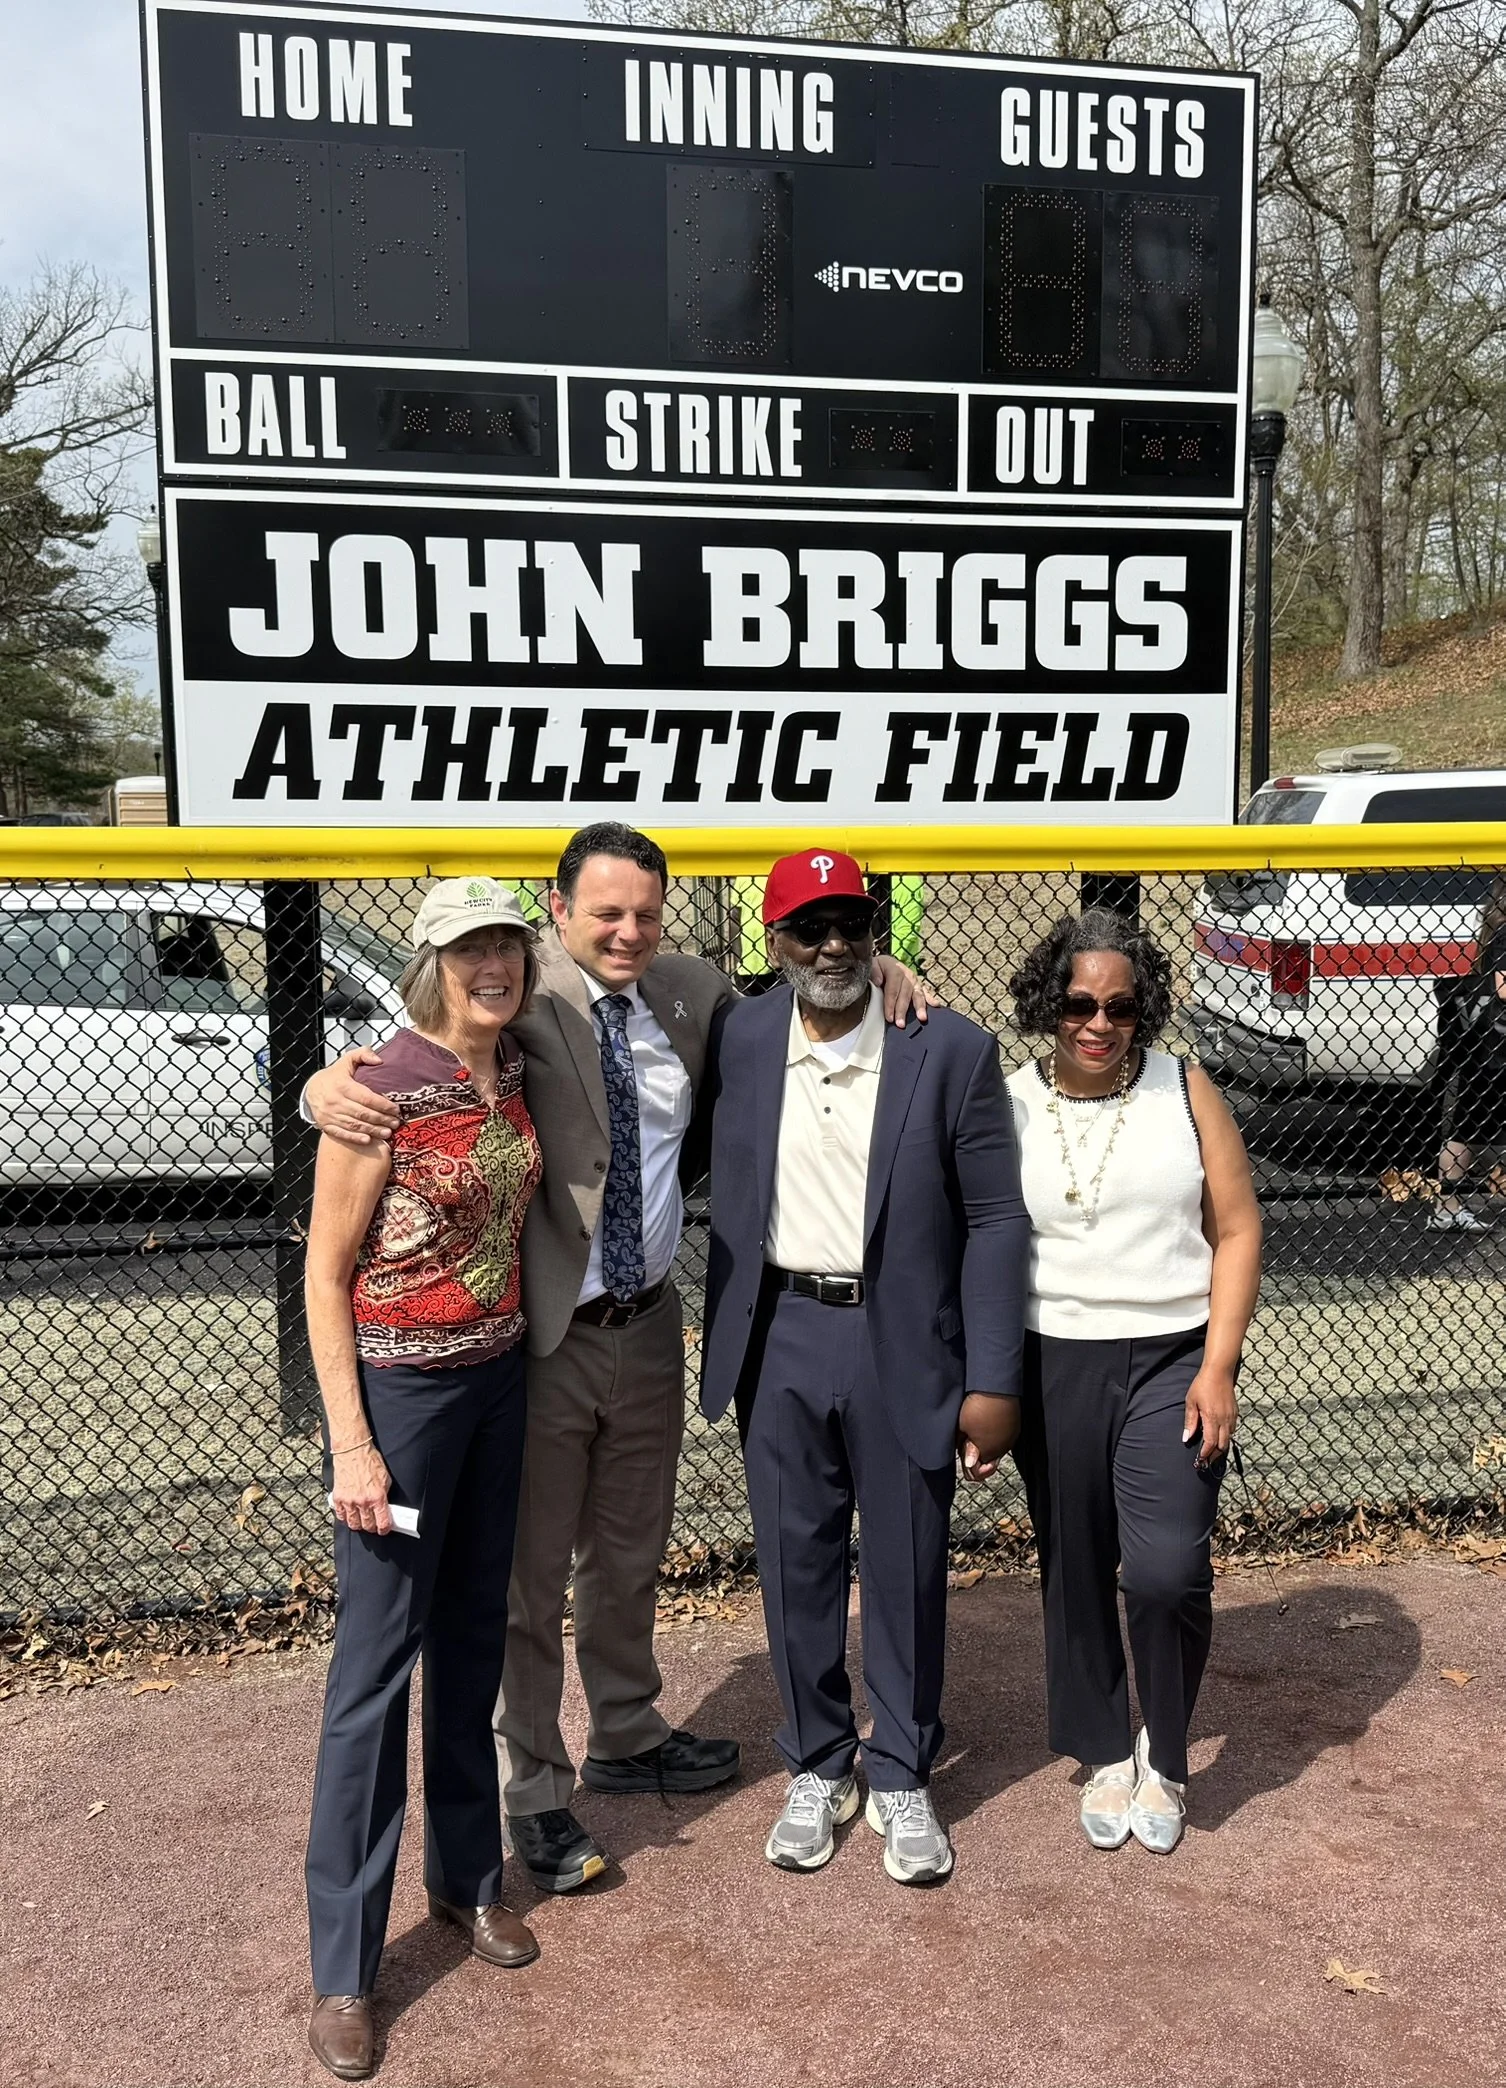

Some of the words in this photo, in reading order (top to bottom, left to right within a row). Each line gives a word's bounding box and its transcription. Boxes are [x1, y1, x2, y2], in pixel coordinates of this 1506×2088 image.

[239, 32, 413, 127] HOME
[625, 59, 833, 153] INNING
[1000, 87, 1205, 178] GUESTS
[841, 266, 964, 293] NEVCO
[204, 371, 347, 460] BALL
[605, 389, 802, 478] STRIKE
[995, 405, 1095, 486] OUT
[228, 531, 643, 666] JOHN
[701, 546, 1189, 672] BRIGGS
[233, 702, 842, 803] ATHLETIC
[874, 711, 1190, 803] FIELD
[810, 855, 835, 884] P
